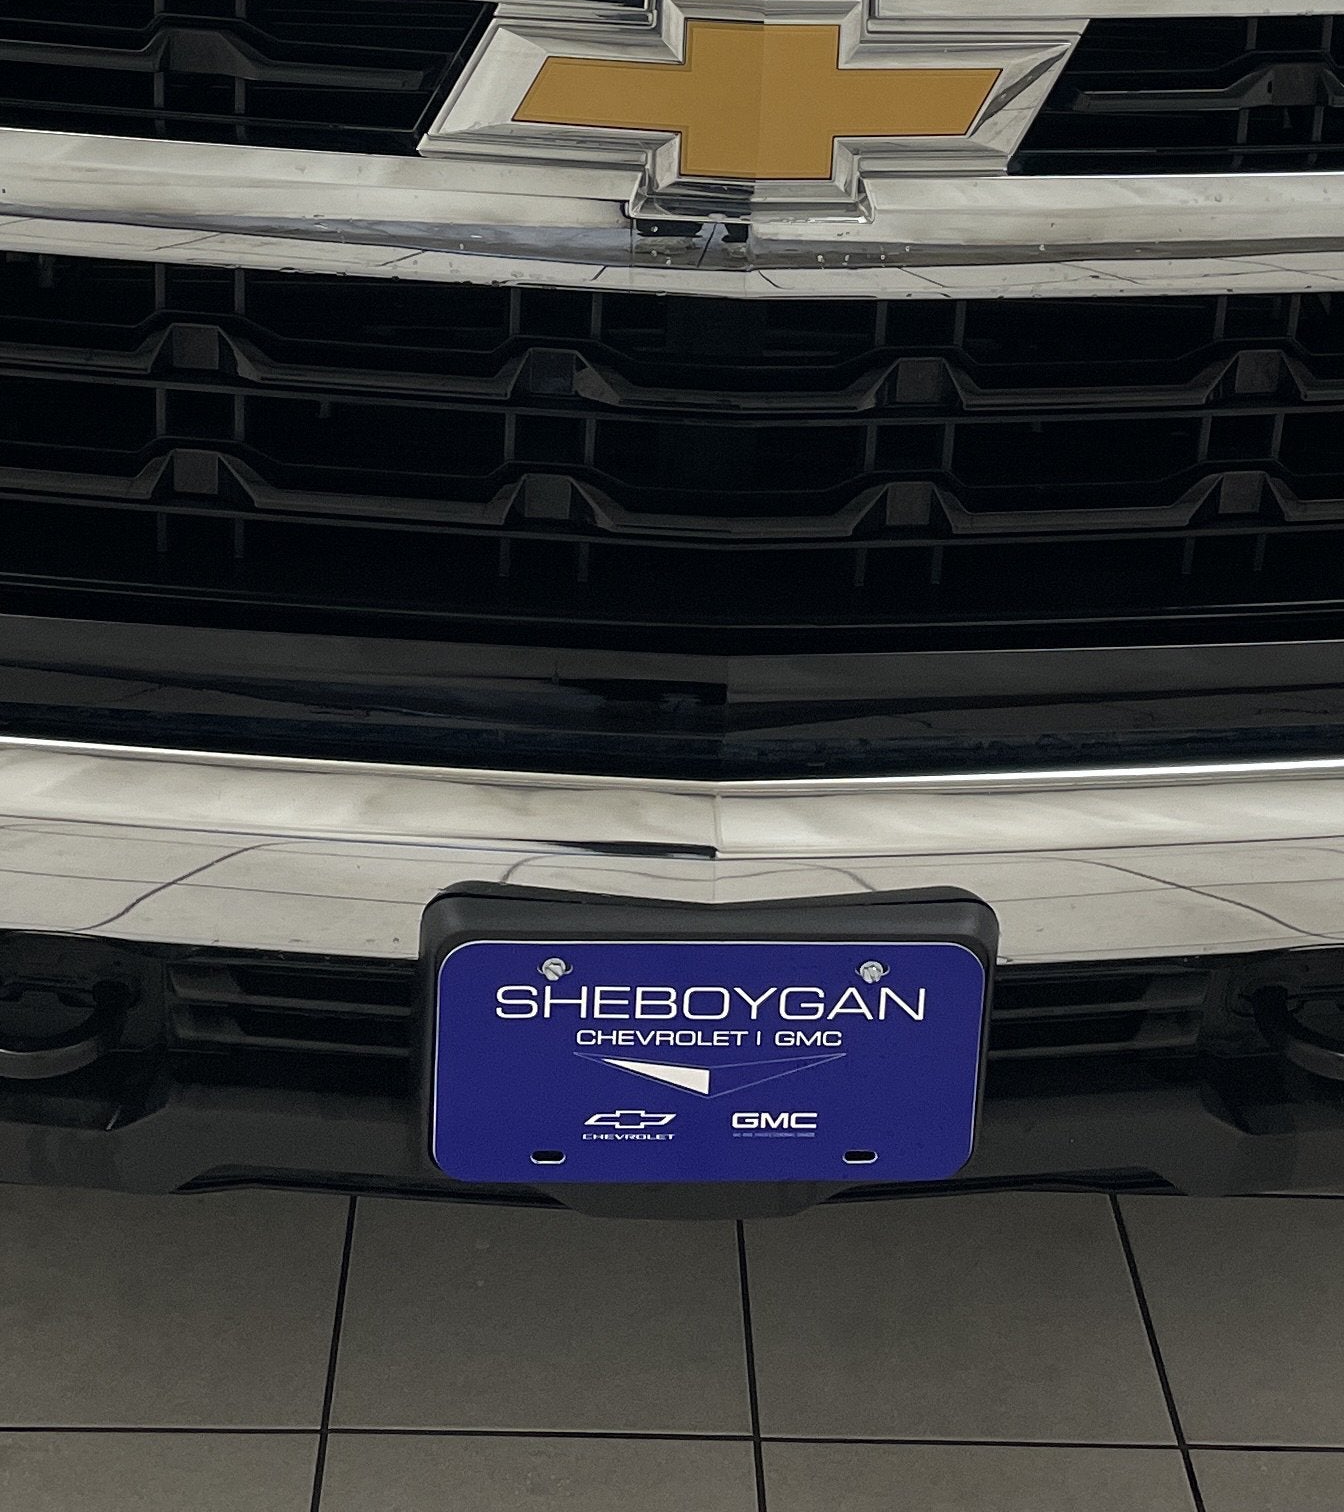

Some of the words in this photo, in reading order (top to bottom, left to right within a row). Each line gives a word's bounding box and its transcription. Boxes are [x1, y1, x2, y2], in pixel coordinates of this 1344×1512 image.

[495, 985, 926, 1021] SHEBOYGAN
[576, 1029, 749, 1046] CHEVROLET
[774, 1030, 842, 1047] GMC
[731, 1112, 818, 1129] GMC
[582, 1133, 675, 1141] CHEVROLET
